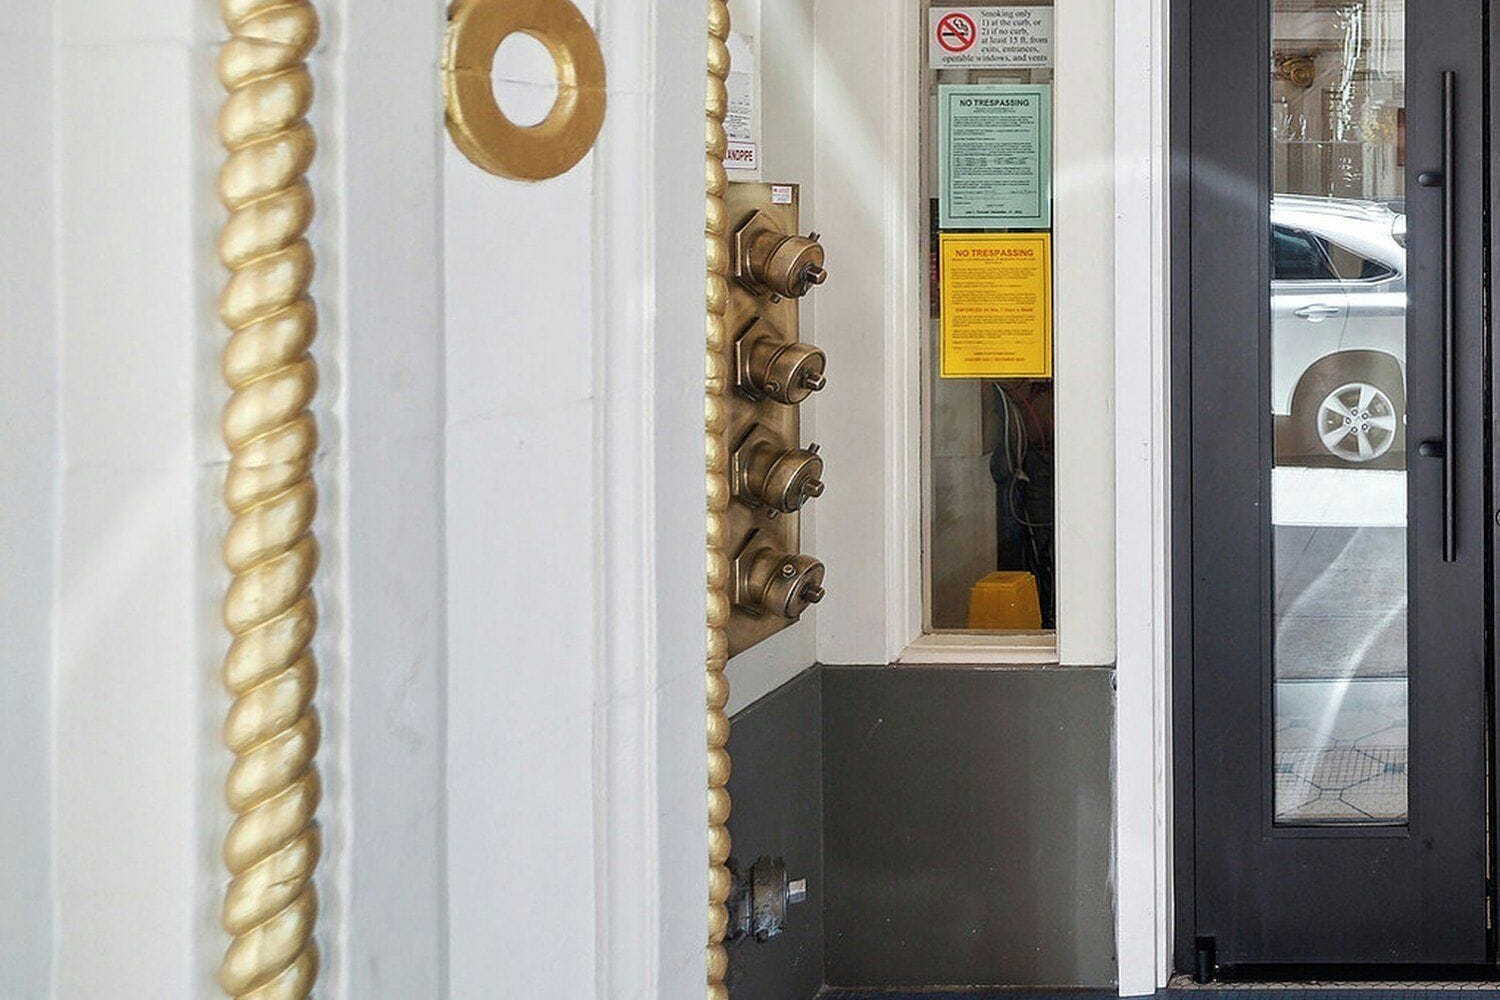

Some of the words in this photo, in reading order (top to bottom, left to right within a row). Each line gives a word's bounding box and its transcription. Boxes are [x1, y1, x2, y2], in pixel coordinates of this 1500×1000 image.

[981, 9, 1014, 18] Smoking
[1014, 9, 1032, 19] only
[1000, 18, 1011, 26] the
[1030, 36, 1048, 44] from
[1012, 55, 1028, 63] and
[1028, 55, 1048, 63] vents
[959, 98, 973, 107] NO
[974, 98, 1030, 107] TRESPASSING
[954, 249, 969, 257] NO
[971, 249, 1035, 257] TRESPASSING
